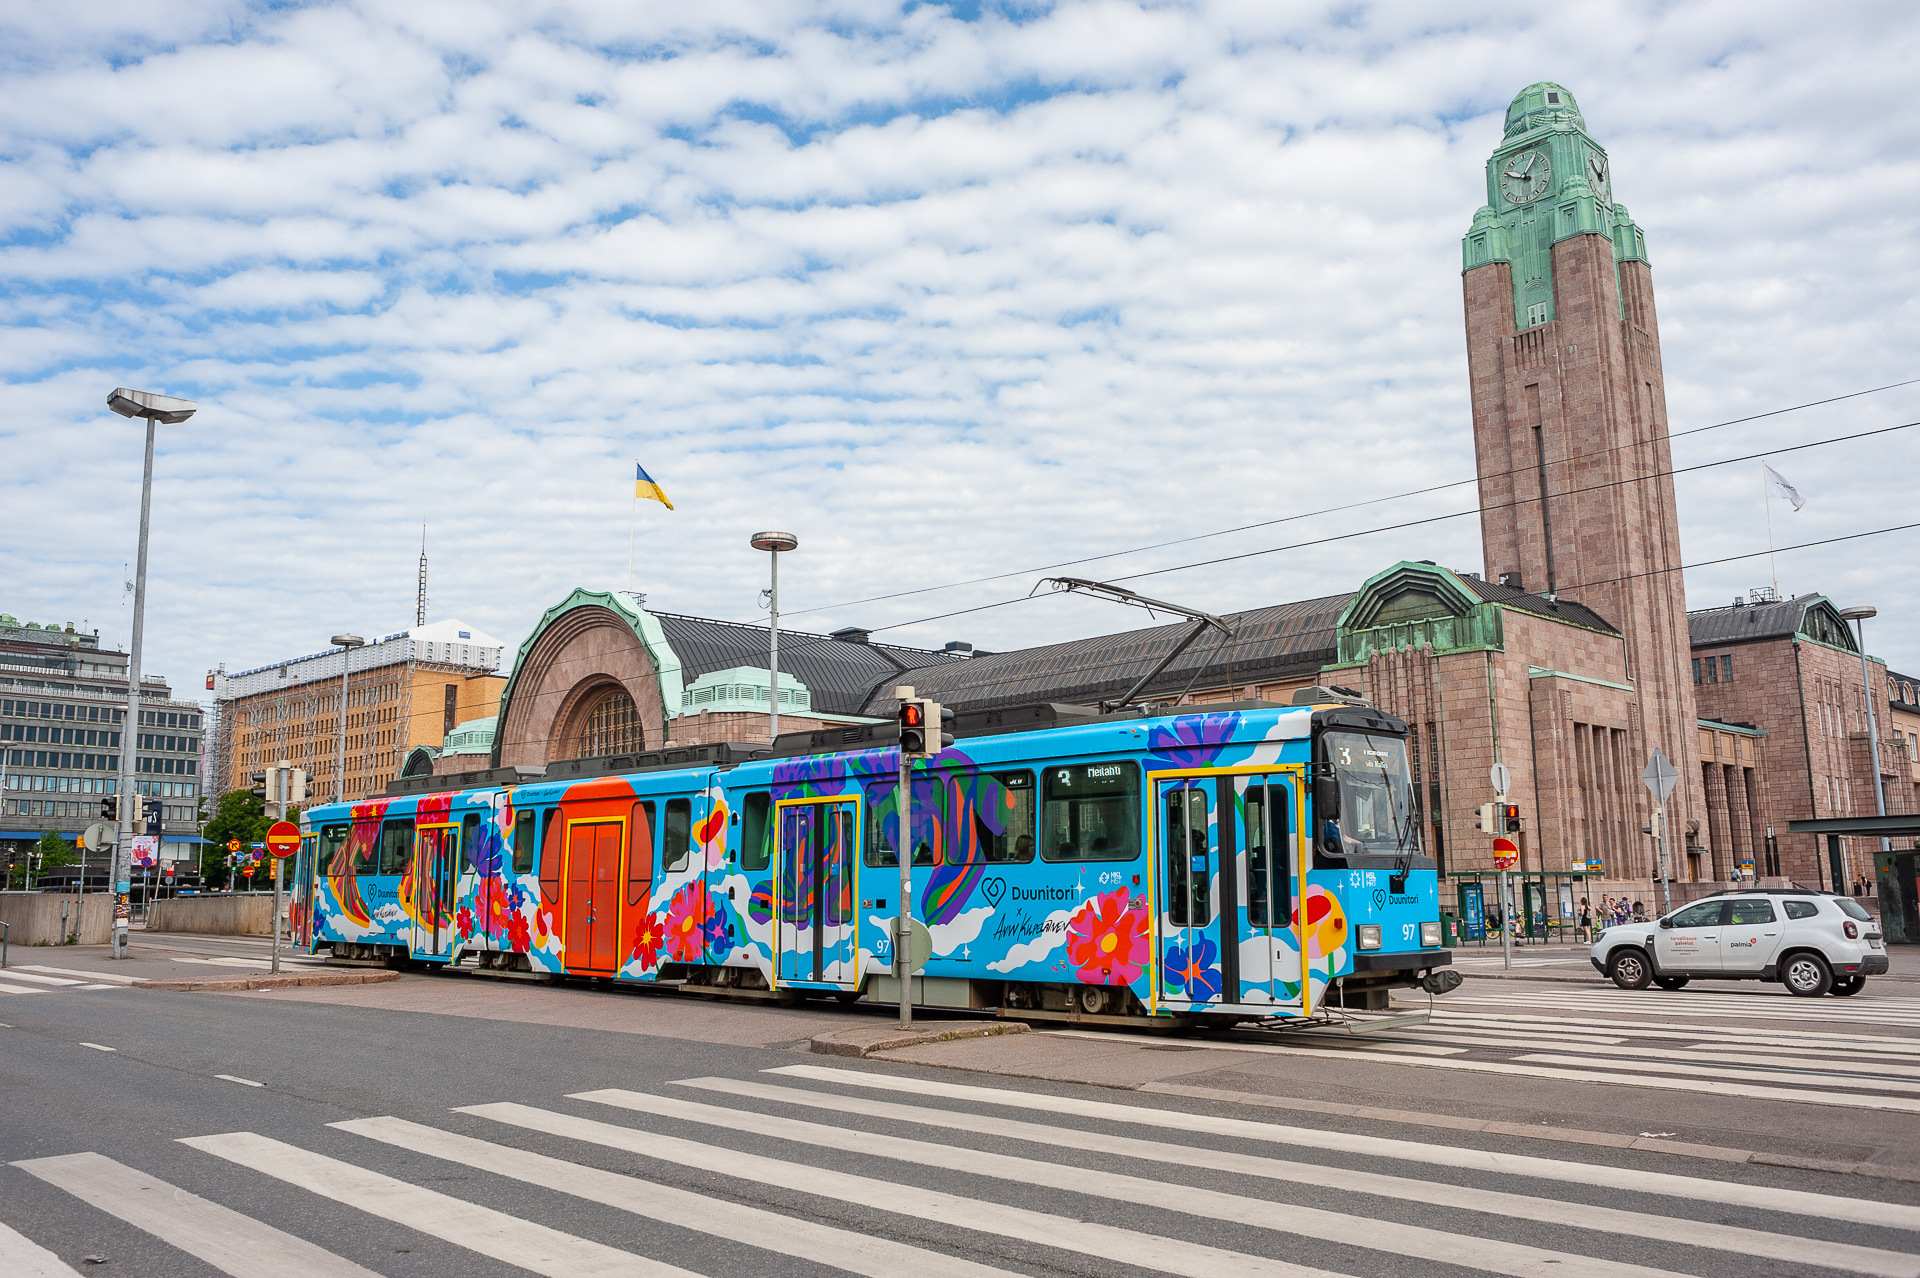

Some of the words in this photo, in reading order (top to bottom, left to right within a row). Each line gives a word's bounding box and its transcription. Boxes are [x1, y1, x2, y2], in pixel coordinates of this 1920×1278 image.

[1339, 747, 1351, 765] 3
[328, 828, 334, 838] 3
[377, 888, 400, 899] Duunitori
[1012, 885, 1074, 900] Duunitori
[1389, 893, 1419, 905] Duunitori
[1402, 923, 1415, 941] 97
[876, 940, 890, 953] 97
